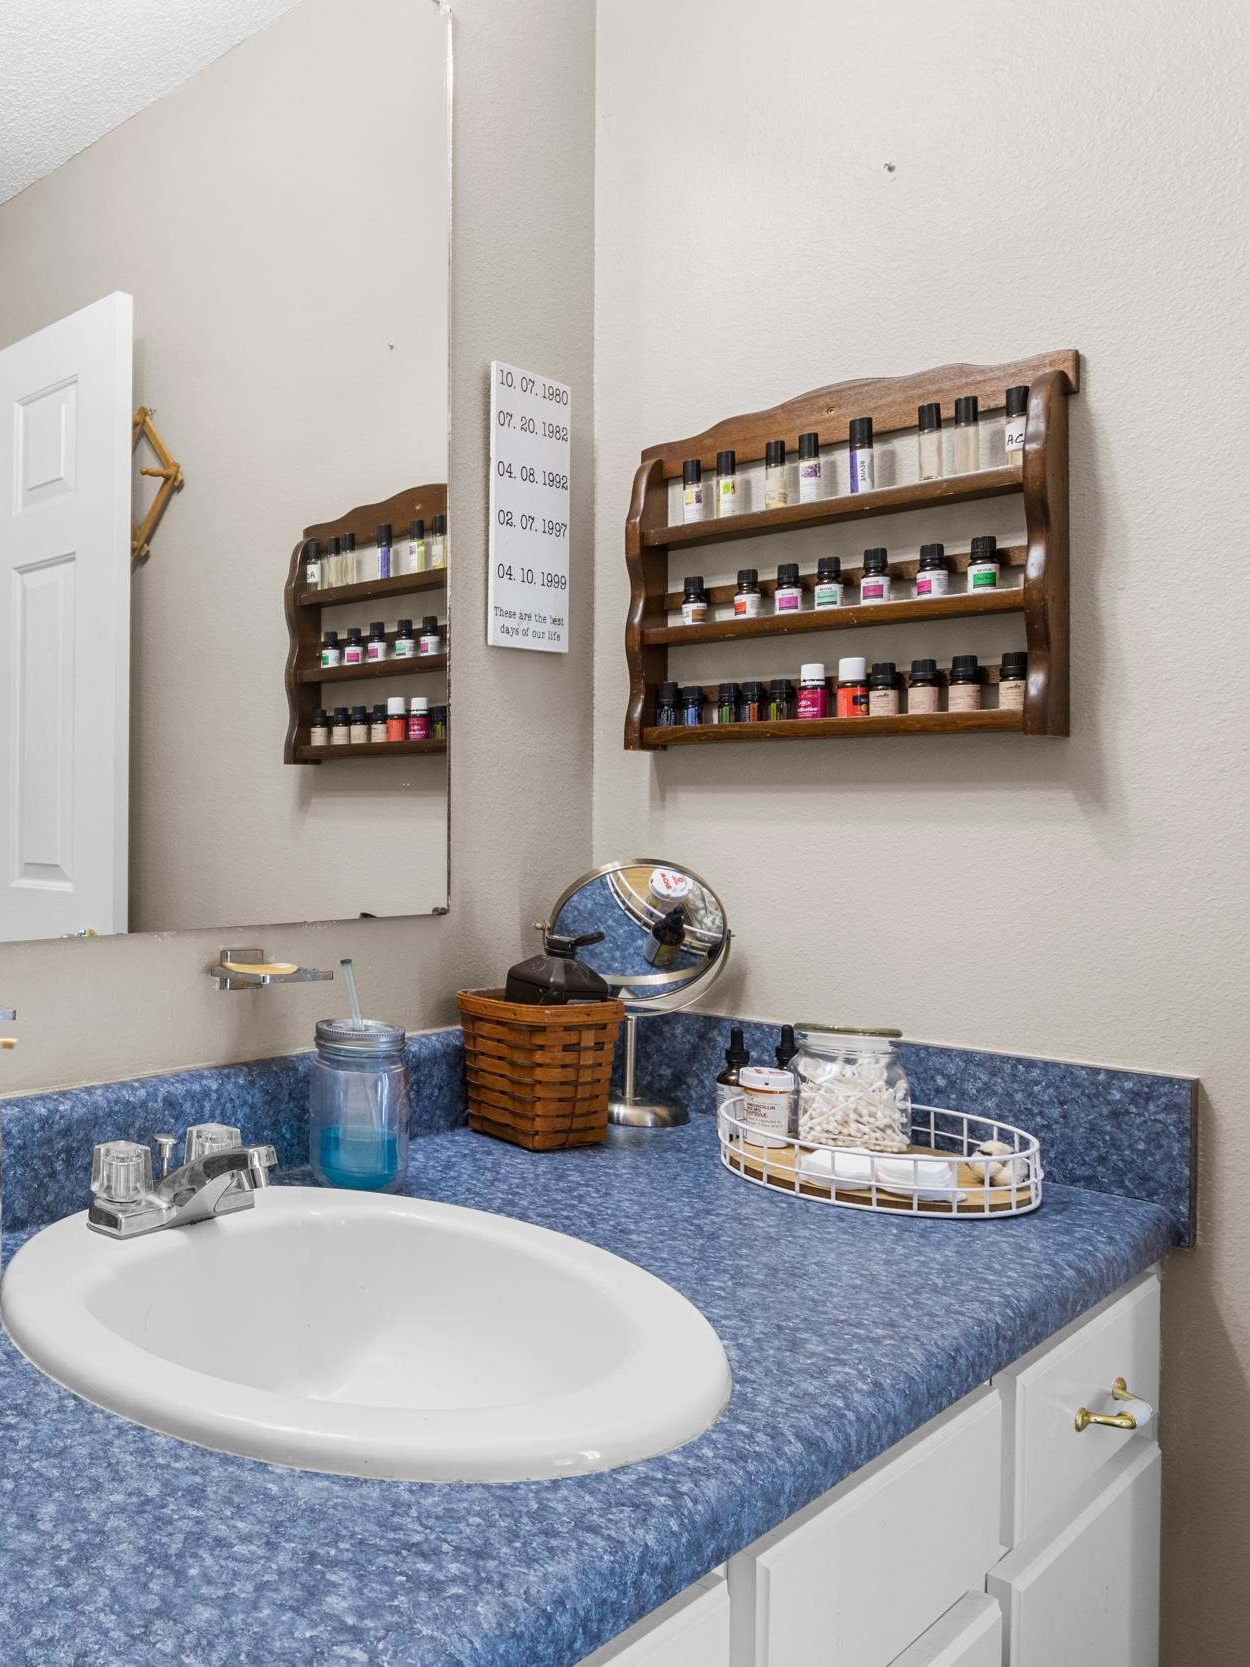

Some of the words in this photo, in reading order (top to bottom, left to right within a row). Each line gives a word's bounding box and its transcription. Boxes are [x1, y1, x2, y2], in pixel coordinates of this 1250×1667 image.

[499, 369, 516, 389] 10.
[520, 376, 538, 396] 07.
[542, 383, 569, 406] 1980
[497, 410, 516, 430] 07.
[520, 416, 538, 435] 20.
[542, 421, 569, 442] 1982
[497, 460, 516, 479] 04.
[520, 465, 538, 484] 08.
[542, 470, 569, 491] 1992
[497, 509, 516, 528] 02.
[520, 514, 538, 533] 07.
[542, 518, 568, 538] 1997
[497, 563, 516, 581] 04.
[520, 567, 537, 585] 10.
[541, 571, 567, 590] 1999
[494, 606, 517, 619] These
[518, 612, 532, 621] are
[534, 612, 547, 624] the
[549, 614, 565, 626] best
[500, 623, 520, 638] days
[521, 627, 530, 637] of
[531, 629, 546, 639] our
[547, 630, 561, 642] life
